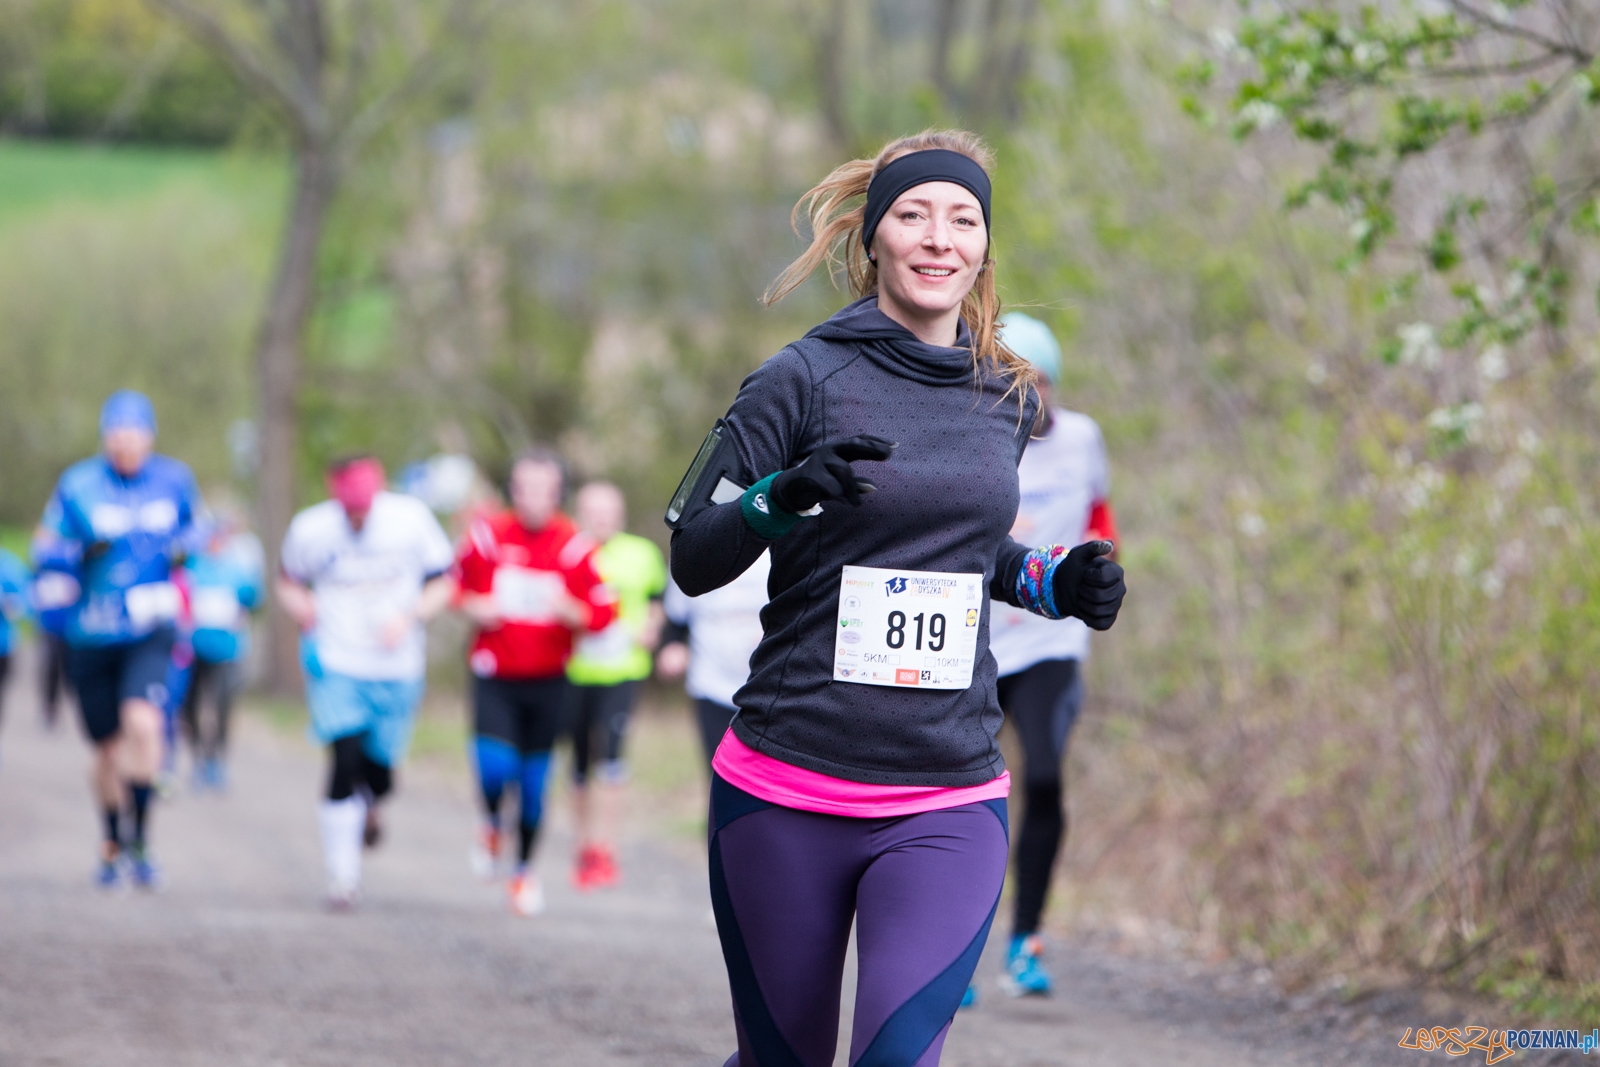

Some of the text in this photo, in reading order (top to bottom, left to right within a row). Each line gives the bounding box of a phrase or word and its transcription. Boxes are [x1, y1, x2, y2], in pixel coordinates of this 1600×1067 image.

[911, 577, 957, 587] UNIWERSYTECKA
[910, 584, 942, 594] ZADYSZKA
[942, 588, 950, 599] IV
[886, 610, 947, 652] 819
[863, 653, 888, 664] 5KM
[937, 657, 959, 668] 10KM
